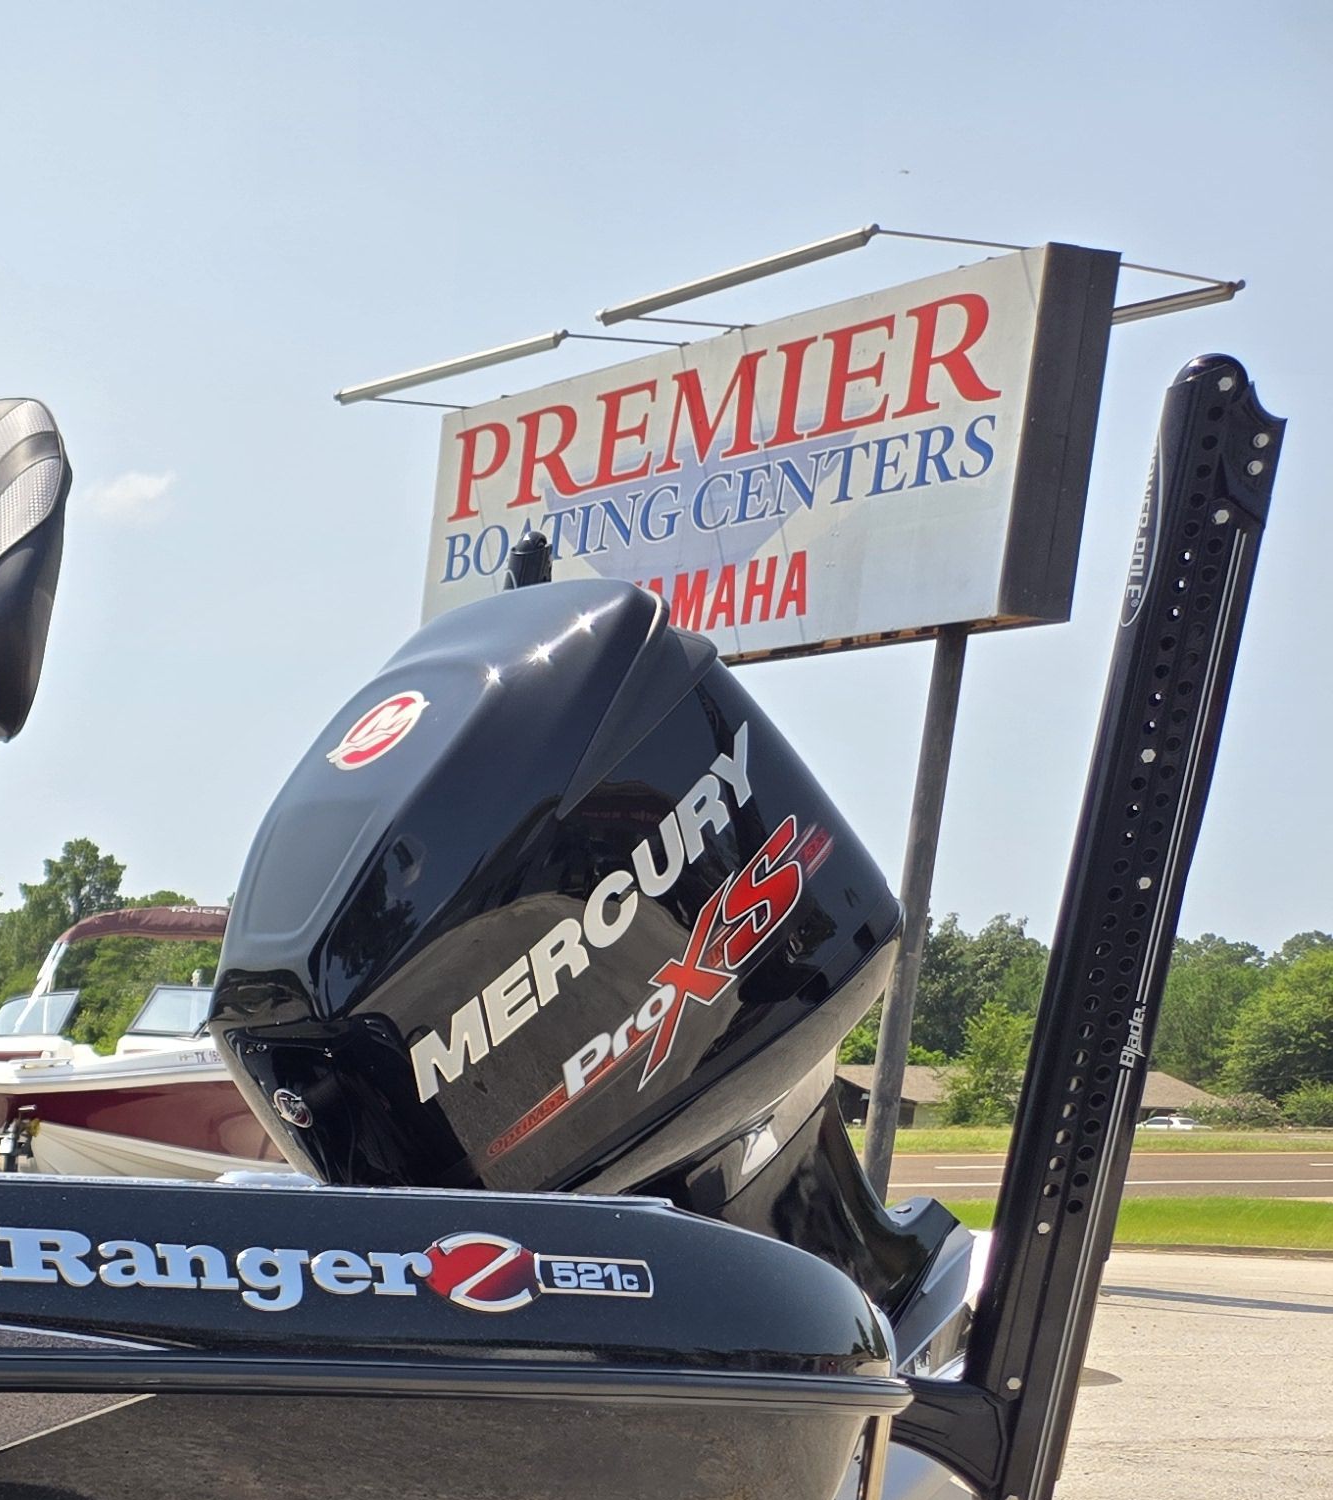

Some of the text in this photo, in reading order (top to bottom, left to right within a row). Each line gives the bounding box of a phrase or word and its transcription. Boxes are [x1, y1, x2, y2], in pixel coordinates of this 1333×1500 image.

[446, 293, 1002, 523] PREMIER
[692, 414, 997, 532] CENTERS
[635, 550, 807, 632] MAHA
[409, 721, 754, 1103] MERCURY
